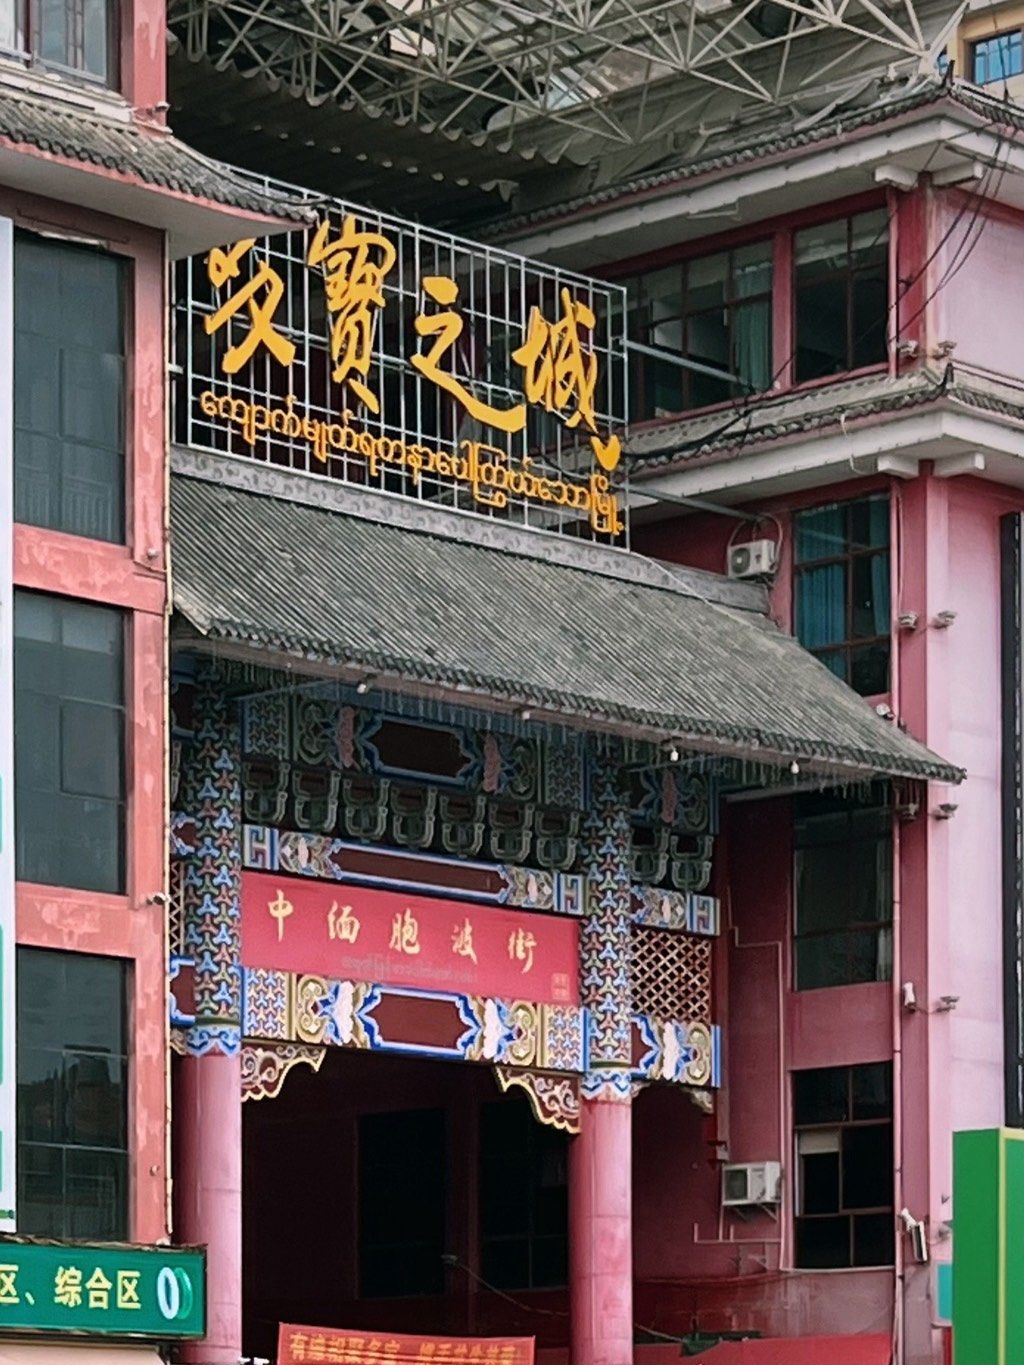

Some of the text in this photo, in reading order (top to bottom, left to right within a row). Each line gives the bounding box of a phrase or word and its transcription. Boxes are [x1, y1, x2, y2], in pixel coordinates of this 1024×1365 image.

[267, 889, 538, 974] 中缅胞波街
